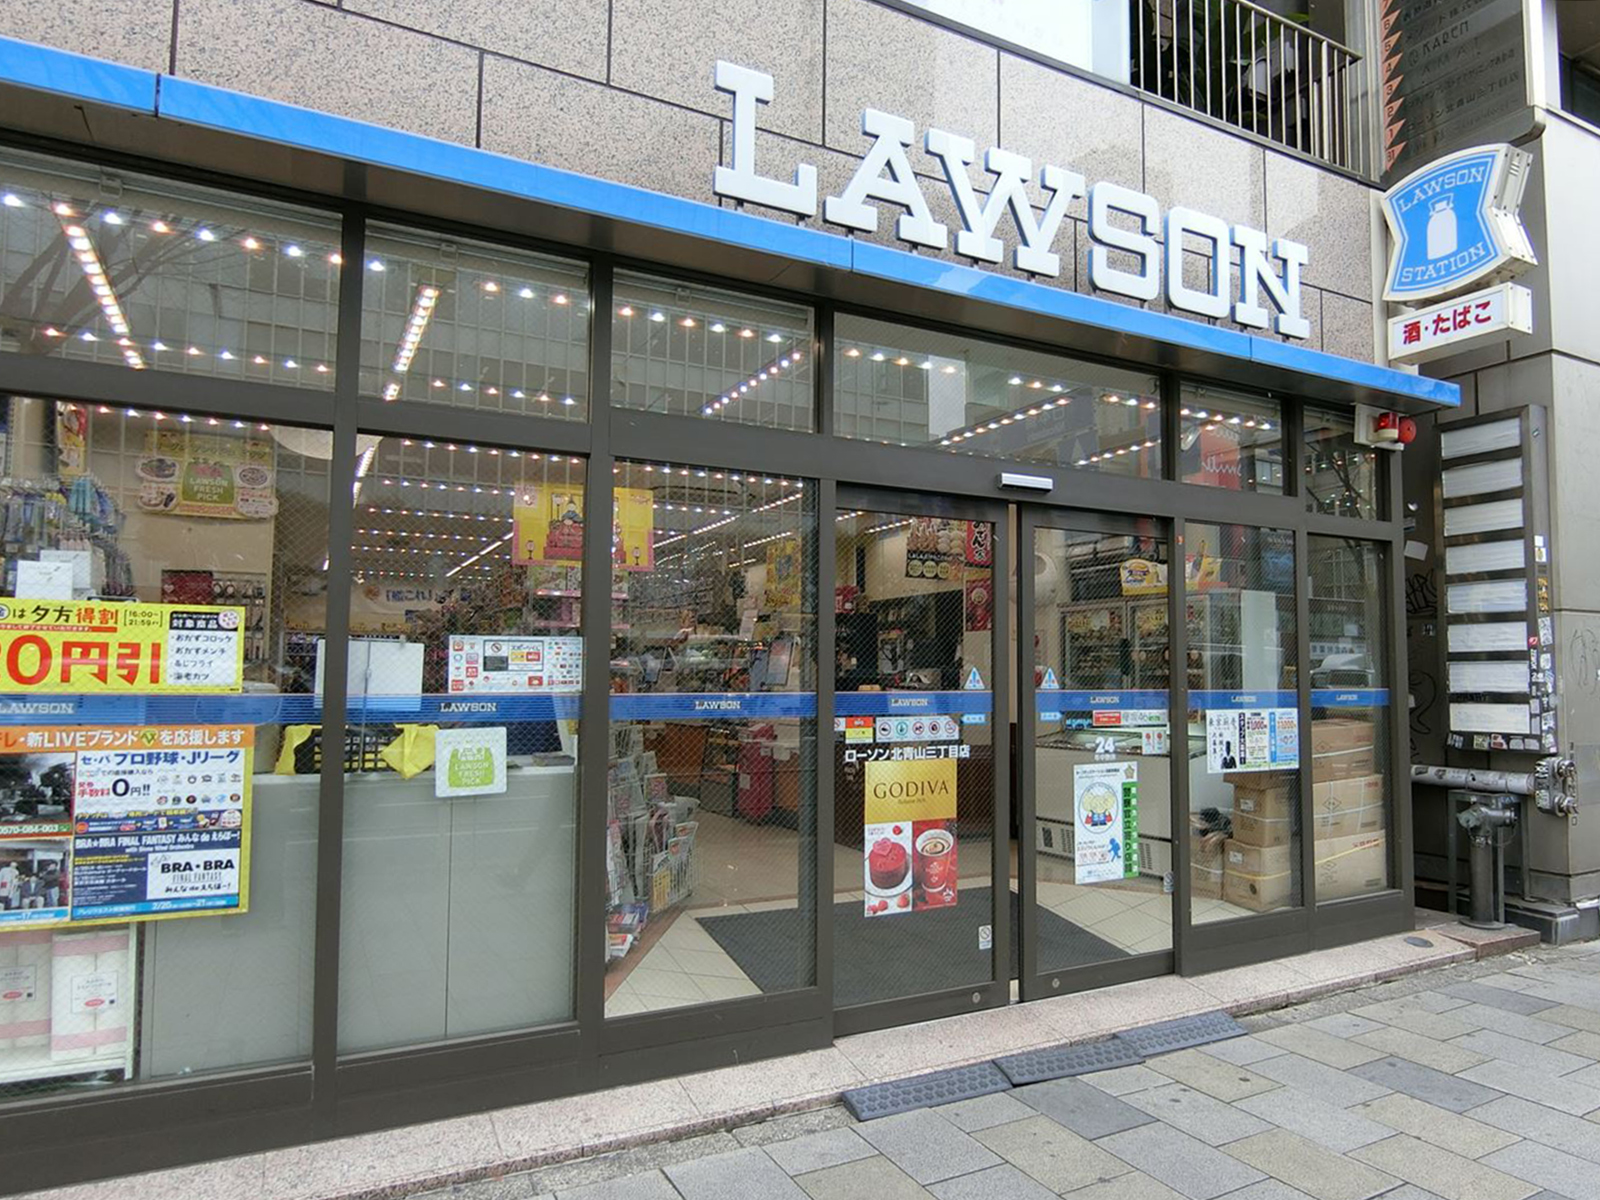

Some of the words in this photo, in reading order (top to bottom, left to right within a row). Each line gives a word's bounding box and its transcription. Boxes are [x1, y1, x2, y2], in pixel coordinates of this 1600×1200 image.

[1384, 19, 1390, 31] 6
[1385, 42, 1391, 52] 5
[1386, 62, 1392, 73] 4
[1386, 84, 1393, 96] 3
[1386, 106, 1394, 118] 2
[1388, 129, 1393, 139] 1
[1398, 166, 1486, 213] LAWSON
[714, 60, 1311, 339] LAWSON
[1401, 241, 1486, 283] STATION
[1403, 300, 1493, 345] 酒・たばこ
[171, 619, 218, 629] 対象商品
[0, 634, 162, 686] 0円引
[440, 702, 498, 713] LAWSON
[695, 700, 742, 710] LAWSON
[890, 698, 929, 707] LAWSON
[160, 729, 245, 745] を応援します
[1094, 736, 1116, 754] 24
[873, 779, 949, 800] GODIVA
[117, 836, 141, 848] FINAL
[141, 833, 176, 847] FANTASY
[172, 873, 193, 884] FINAL
[193, 871, 222, 882] FANTASY
